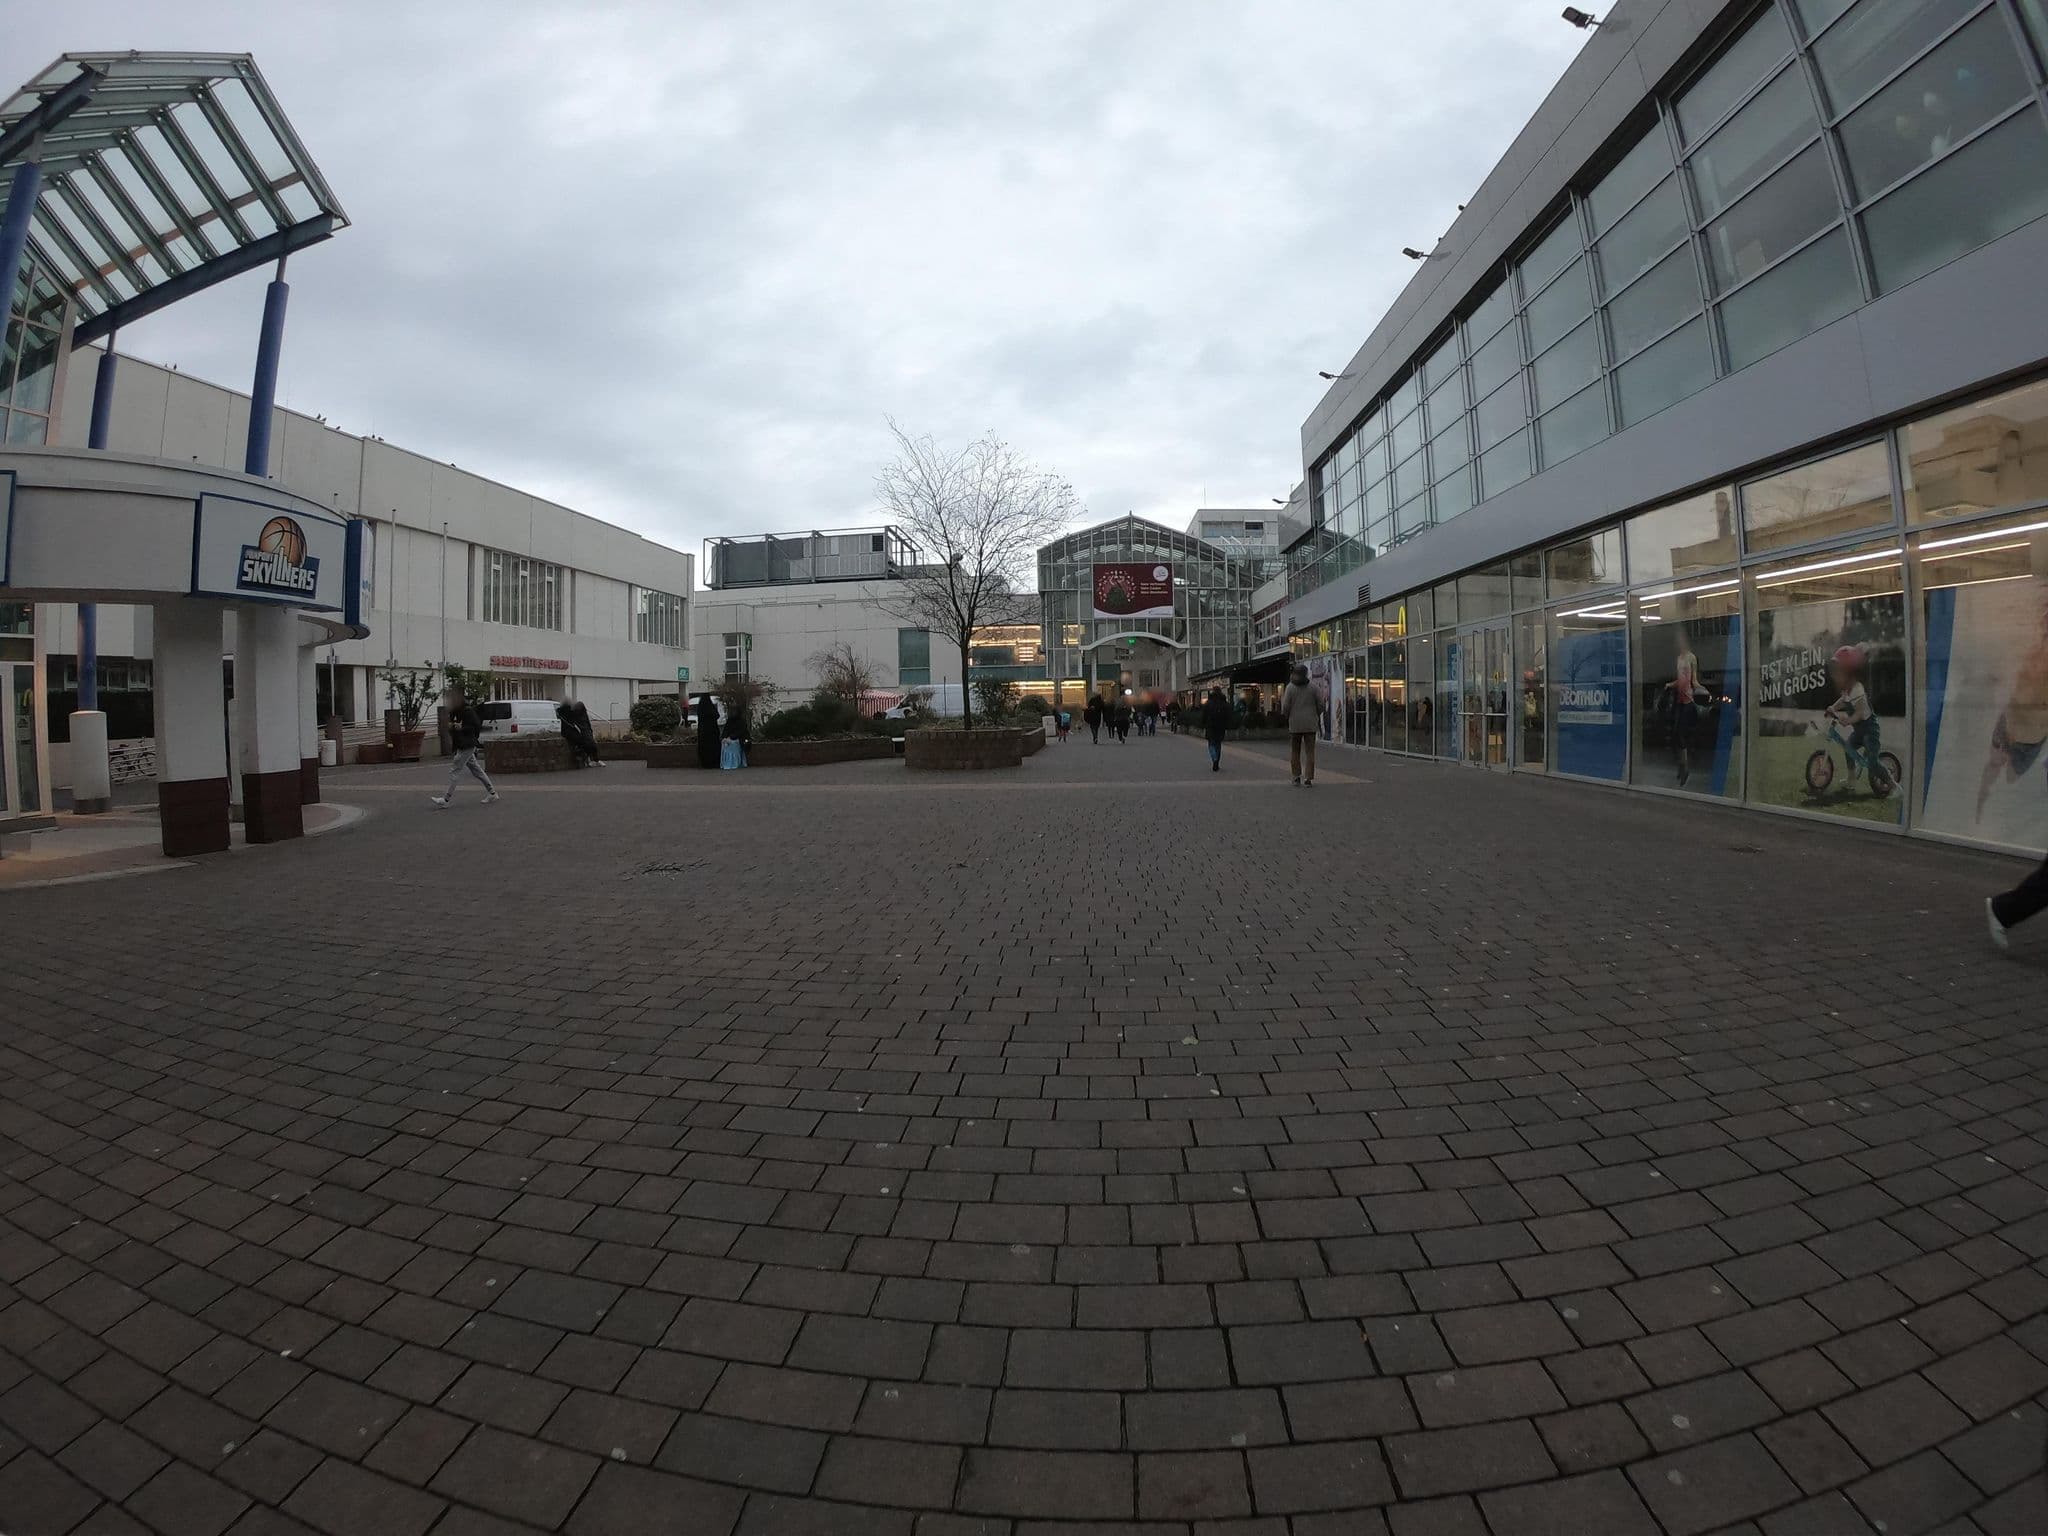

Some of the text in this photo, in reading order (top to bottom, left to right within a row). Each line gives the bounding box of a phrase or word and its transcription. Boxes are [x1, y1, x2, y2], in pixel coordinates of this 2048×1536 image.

[242, 547, 315, 590] SKYLINERS
[1761, 646, 1826, 681] RST KLEIN,
[1559, 688, 1610, 706] DECATHLON
[1783, 668, 1826, 697] GROSS
